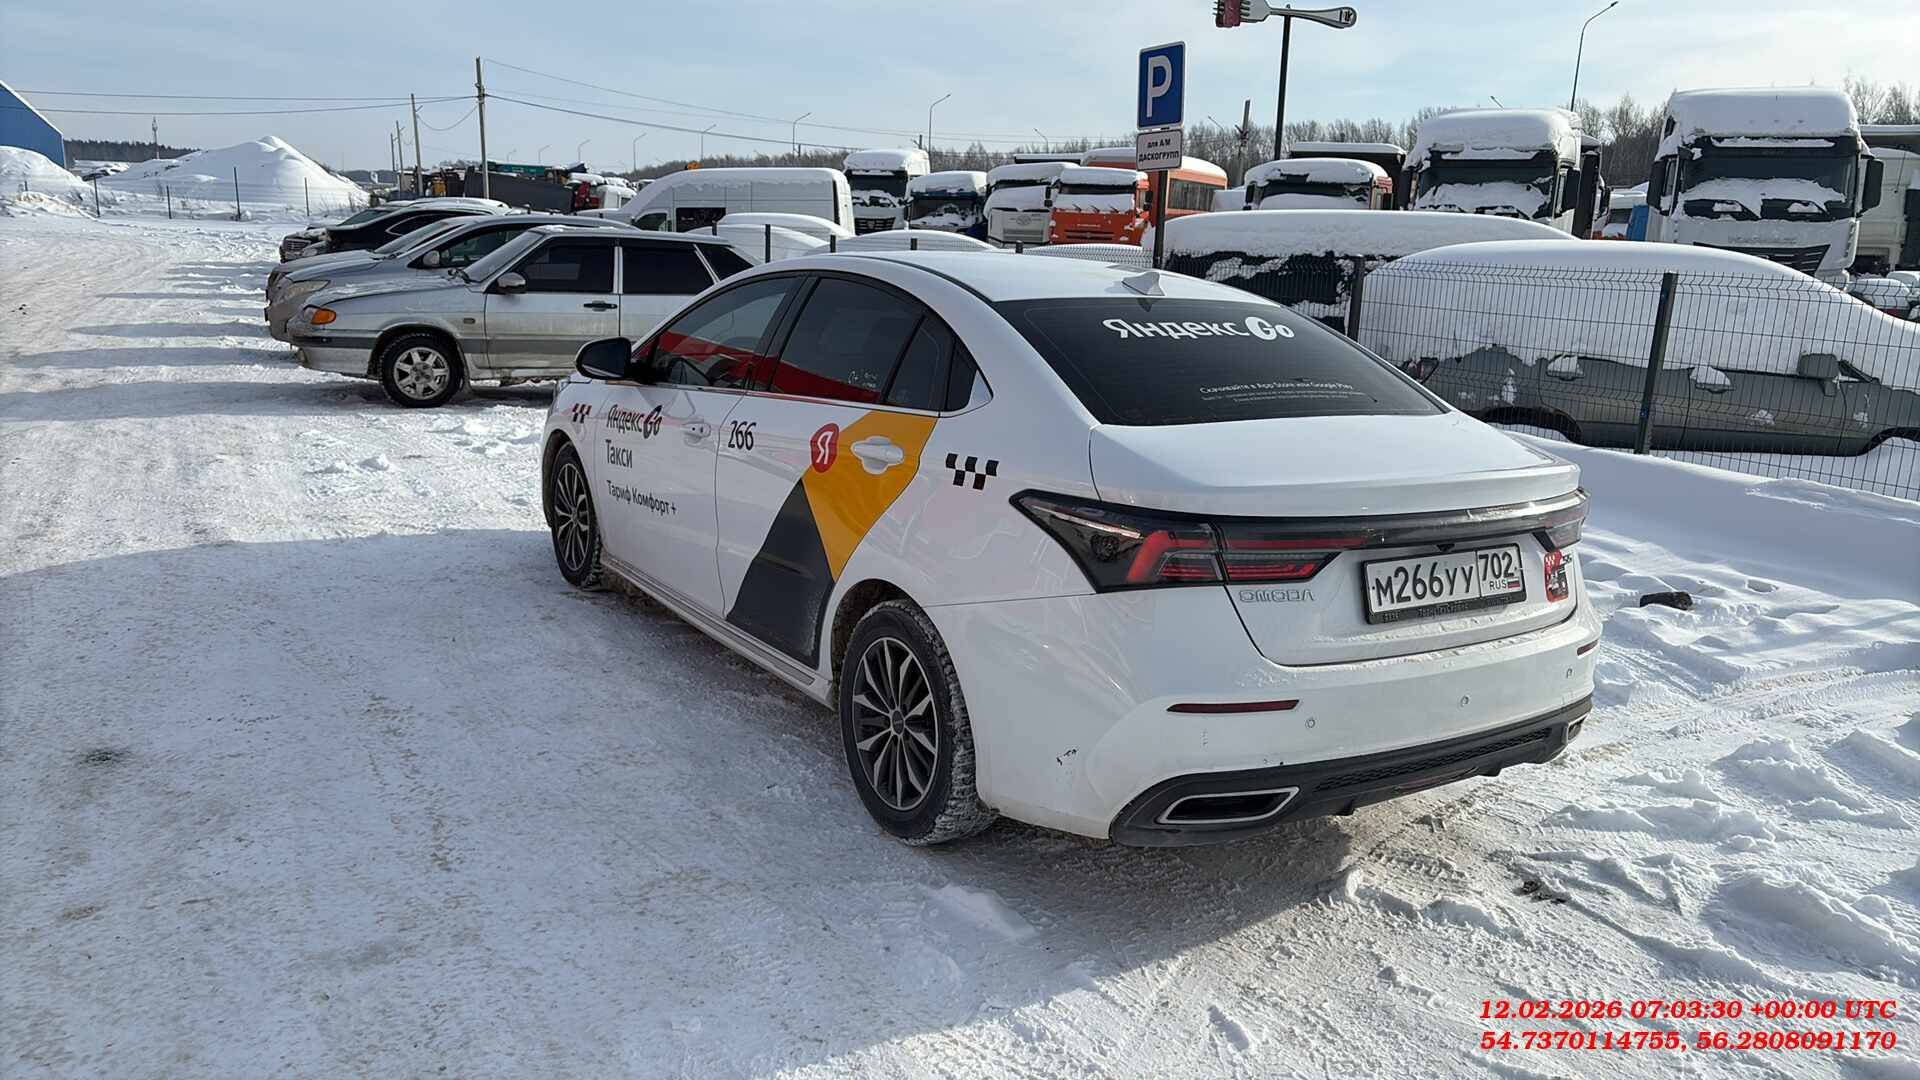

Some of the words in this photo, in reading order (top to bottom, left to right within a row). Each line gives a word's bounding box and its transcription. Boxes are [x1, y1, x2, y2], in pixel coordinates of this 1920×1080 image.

[1146, 54, 1173, 118] P
[1138, 150, 1180, 162] ДАСКОГРУПП
[1102, 318, 1250, 340] Яндекс
[1244, 316, 1295, 341] Go
[606, 403, 644, 435] Яндекс
[643, 404, 663, 440] Go
[727, 419, 757, 451] 266
[605, 438, 633, 469] Такси
[816, 430, 834, 465] Я
[606, 479, 632, 505] Тариф
[632, 487, 670, 517] Комфорт
[1478, 550, 1516, 582] 702
[1239, 588, 1315, 603] OMODA
[1489, 579, 1508, 591] RUS
